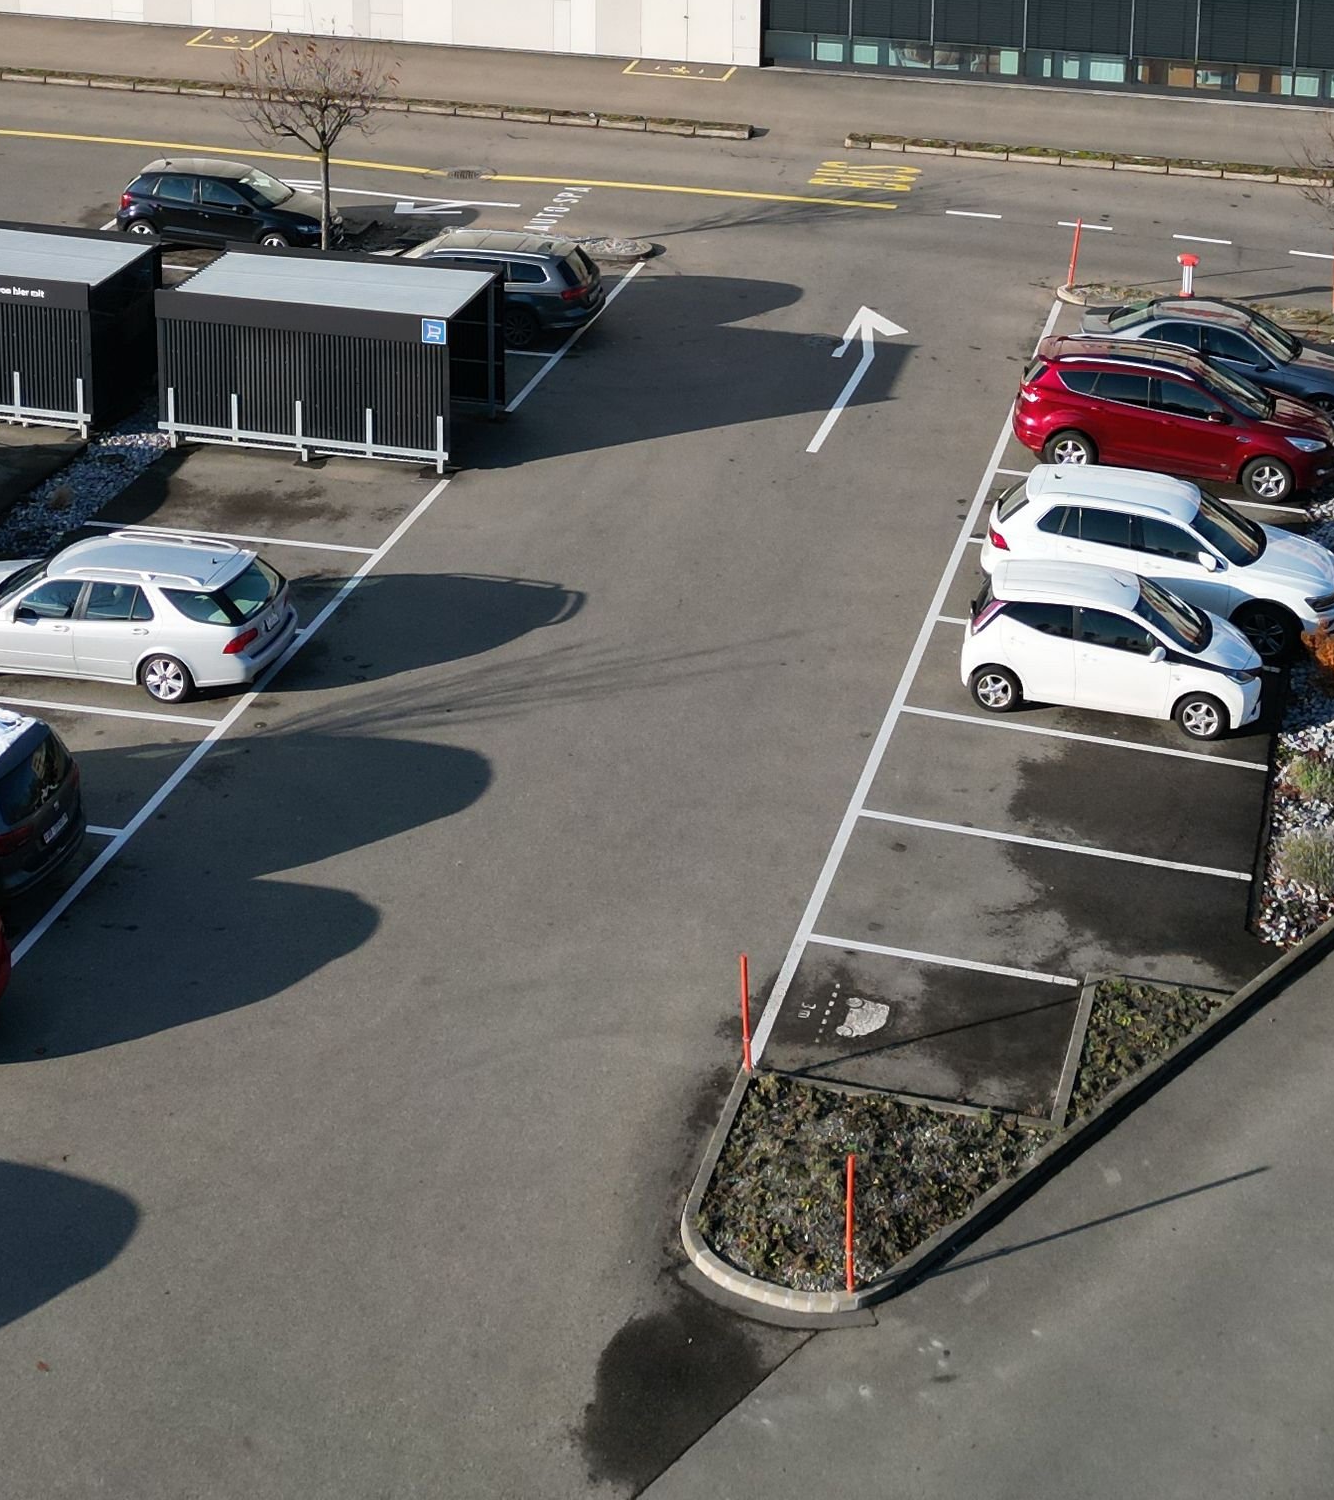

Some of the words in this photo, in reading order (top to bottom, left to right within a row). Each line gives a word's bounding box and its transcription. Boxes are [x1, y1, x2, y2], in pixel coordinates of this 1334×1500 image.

[808, 161, 922, 191] BUS
[13, 286, 29, 296] hier
[31, 289, 45, 298] mit
